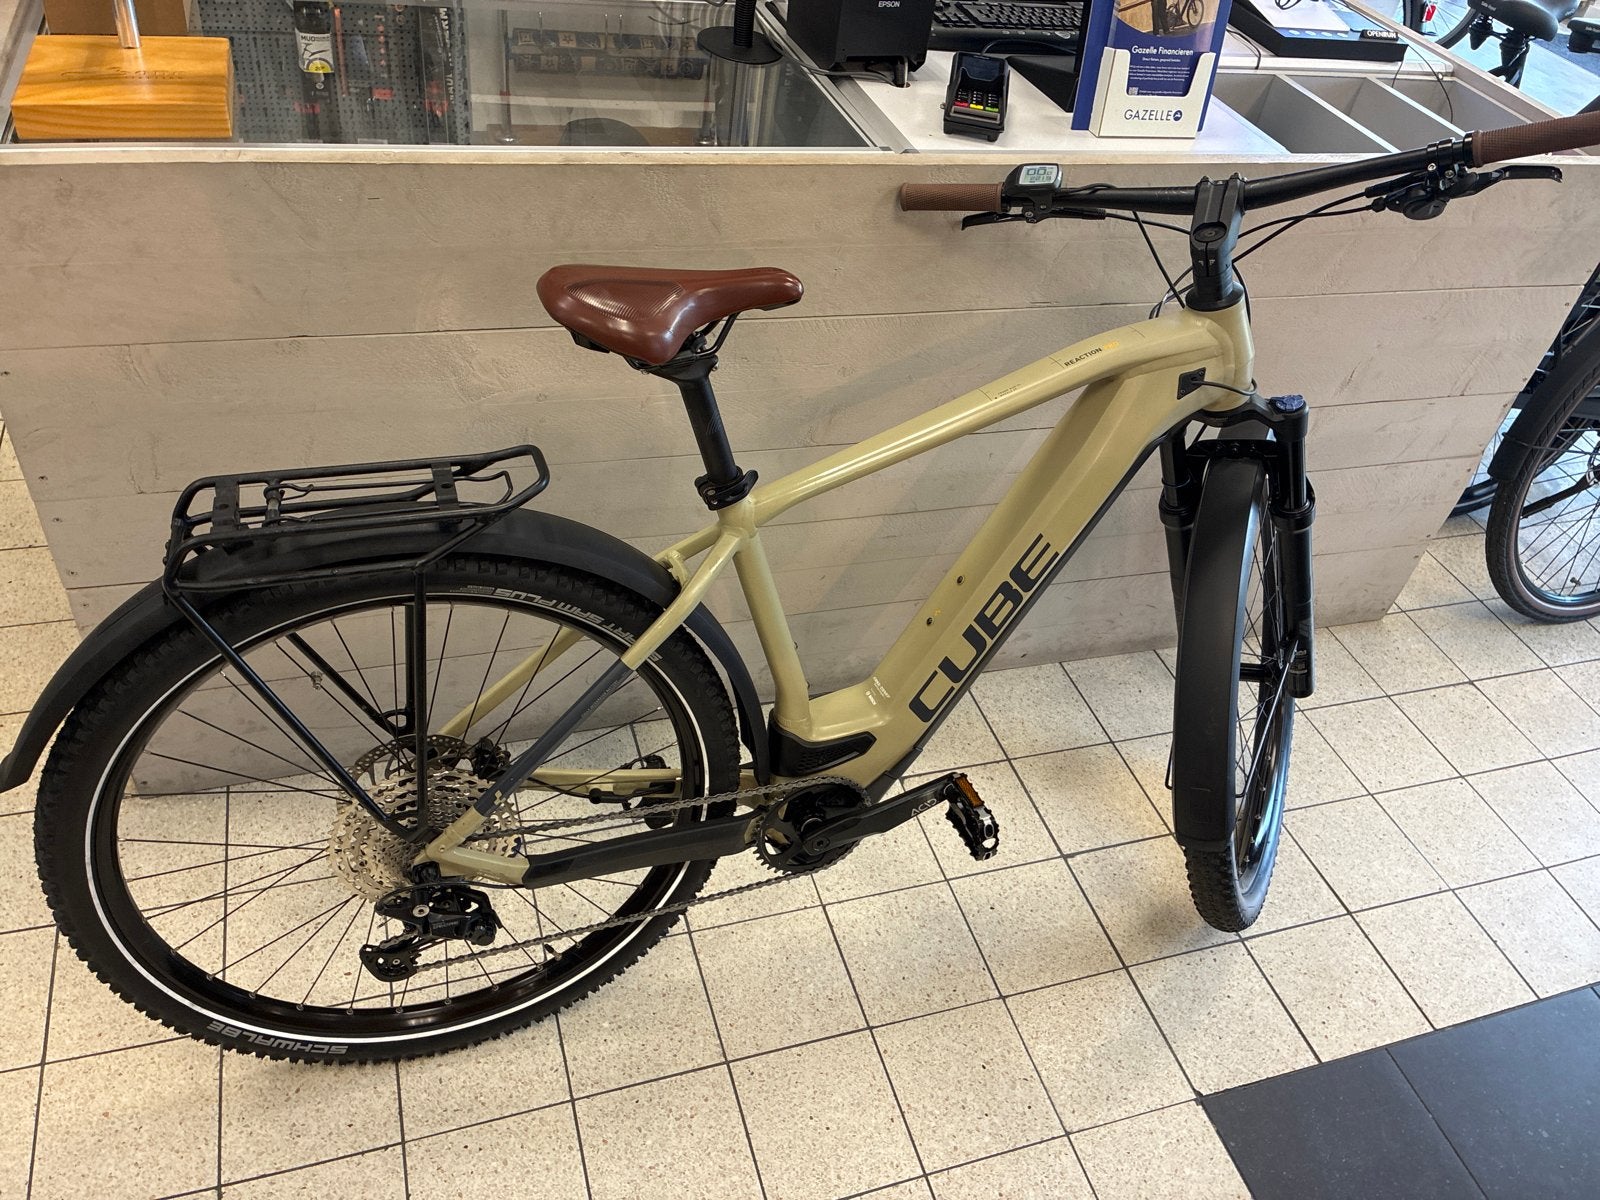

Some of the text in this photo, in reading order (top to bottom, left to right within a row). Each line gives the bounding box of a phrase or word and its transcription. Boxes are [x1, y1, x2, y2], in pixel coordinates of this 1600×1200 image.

[1131, 45, 1193, 56] Gazelle Financieren
[1124, 108, 1173, 121] GAZELLE
[1064, 347, 1103, 367] REACTION
[493, 588, 556, 608] PLUS
[559, 601, 605, 625] SAM
[908, 533, 1060, 723] CUBE
[911, 798, 937, 817] ACID
[206, 1020, 349, 1055] SCHWALBE
